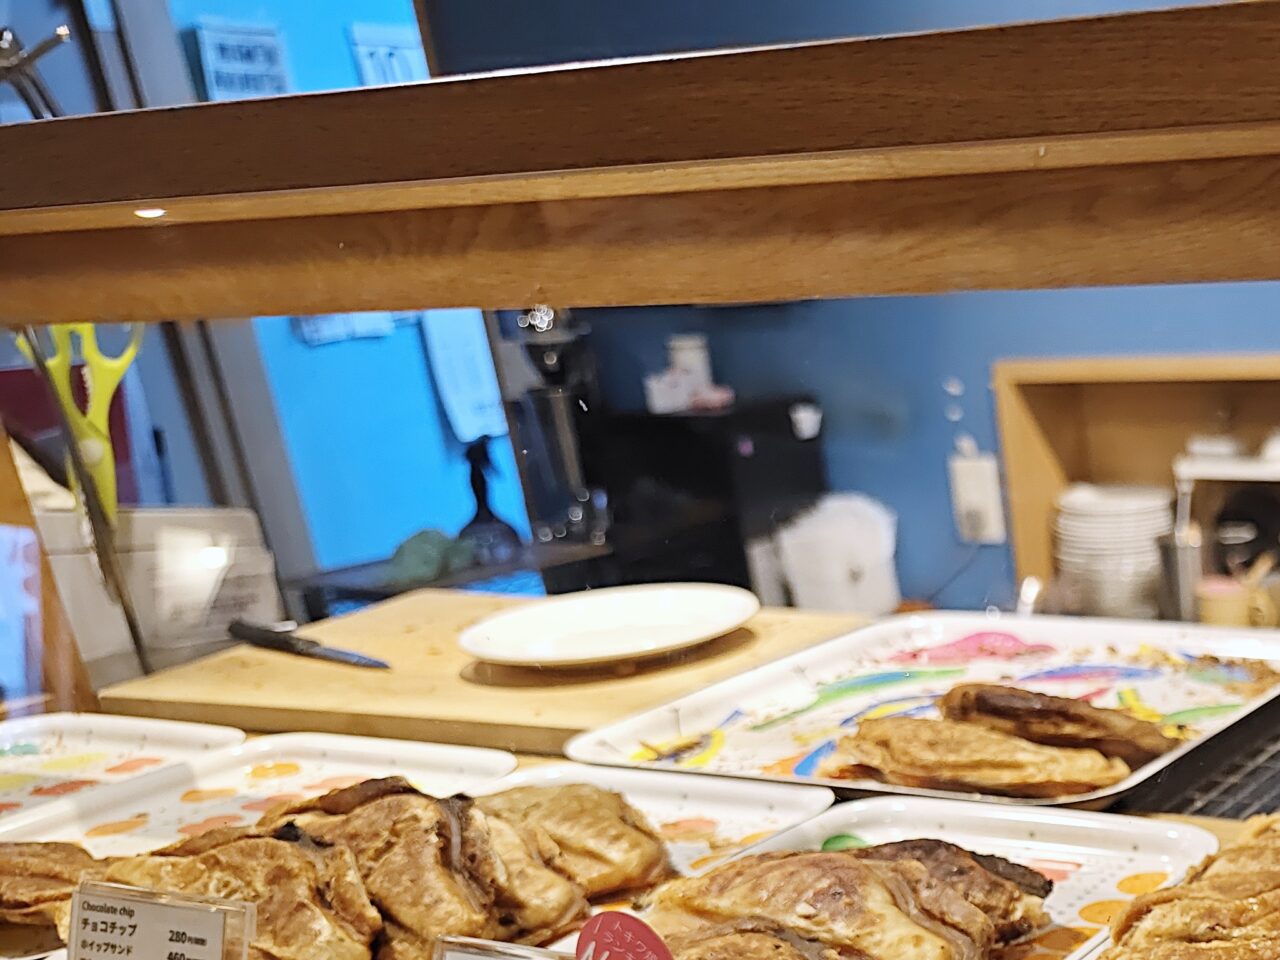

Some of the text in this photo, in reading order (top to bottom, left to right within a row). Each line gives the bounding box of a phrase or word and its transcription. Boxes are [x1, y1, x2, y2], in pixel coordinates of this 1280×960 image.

[82, 901, 135, 919] Chocolate chip
[81, 918, 137, 936] チョコチップ
